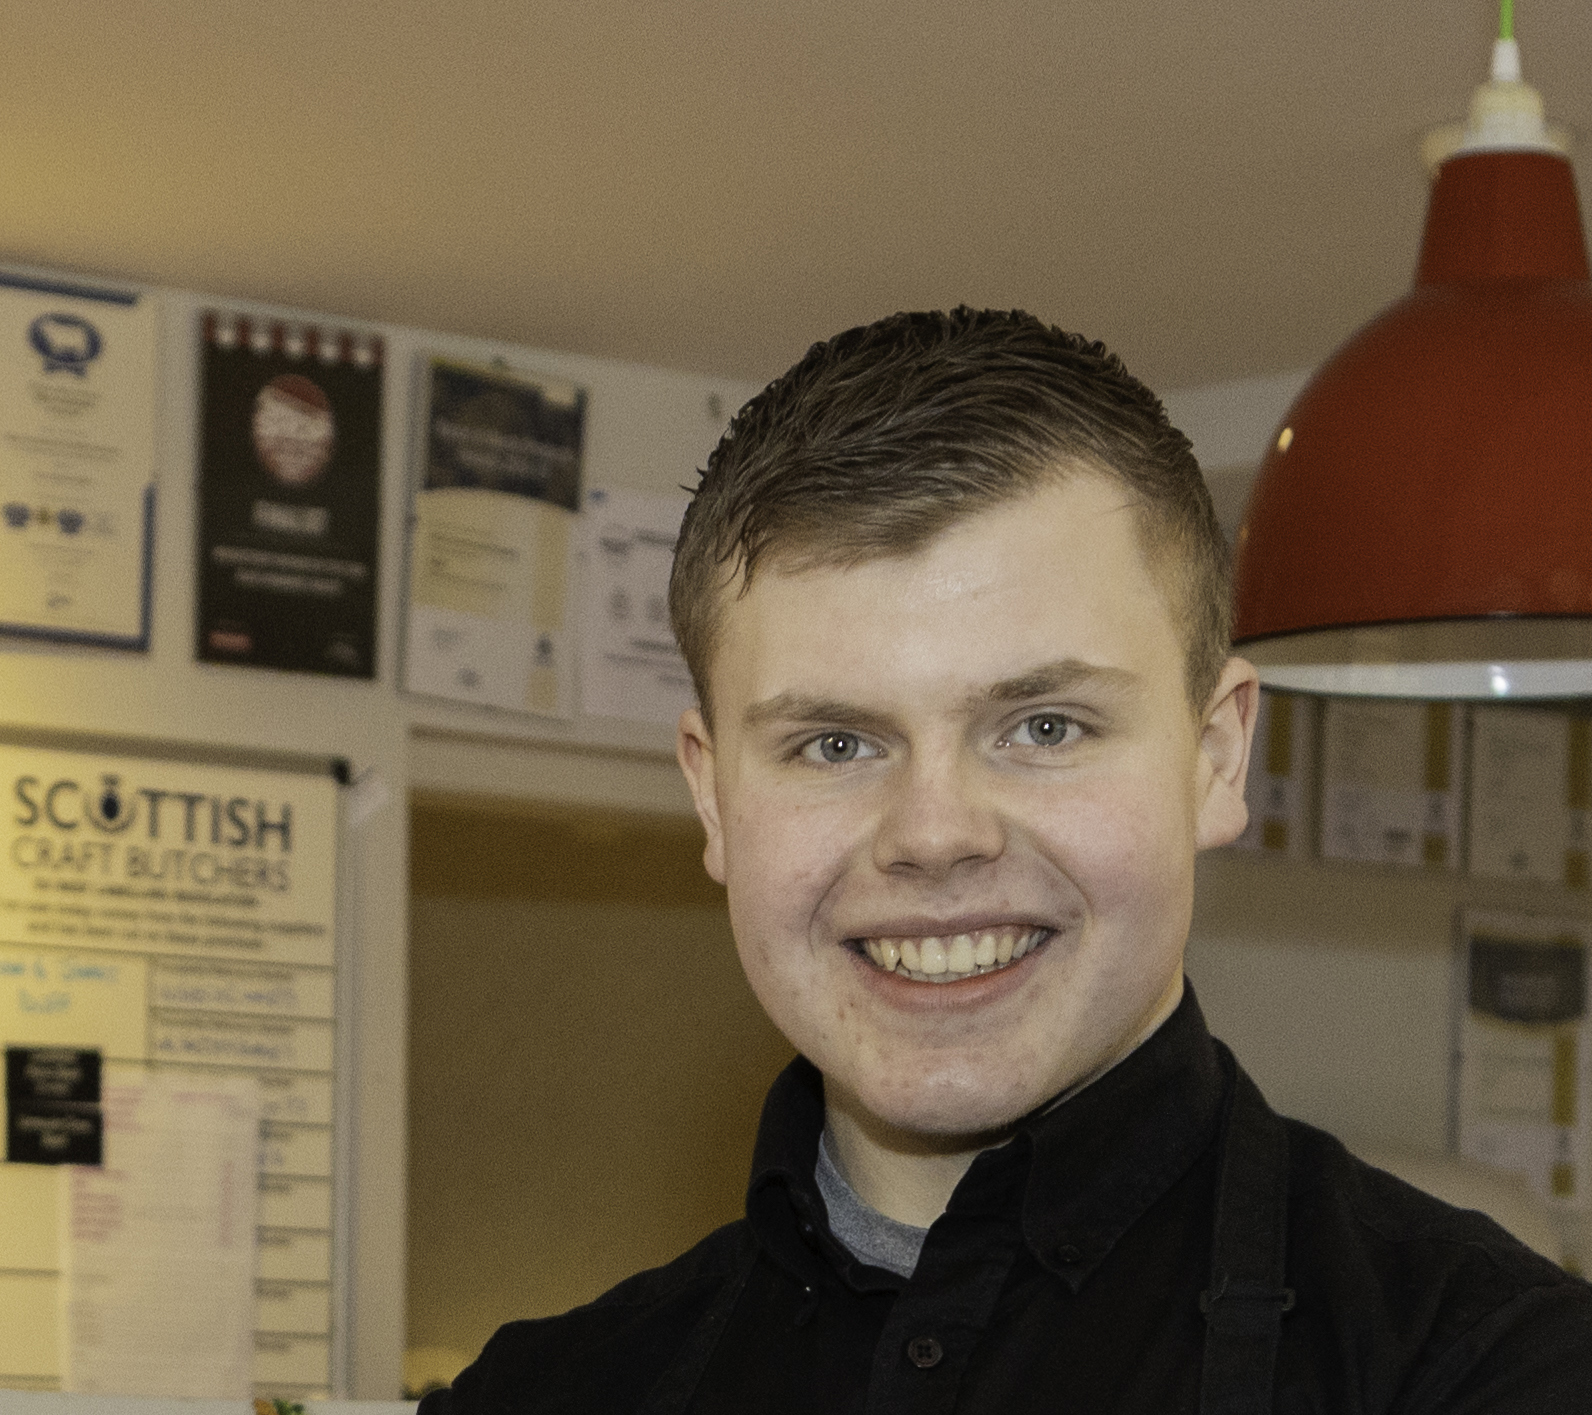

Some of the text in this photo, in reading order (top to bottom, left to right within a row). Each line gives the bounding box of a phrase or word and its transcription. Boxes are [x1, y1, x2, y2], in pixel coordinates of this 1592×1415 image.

[14, 774, 292, 851] SCOTTISH
[12, 835, 113, 877] CRAFT
[125, 845, 290, 892] BUTCHERS
